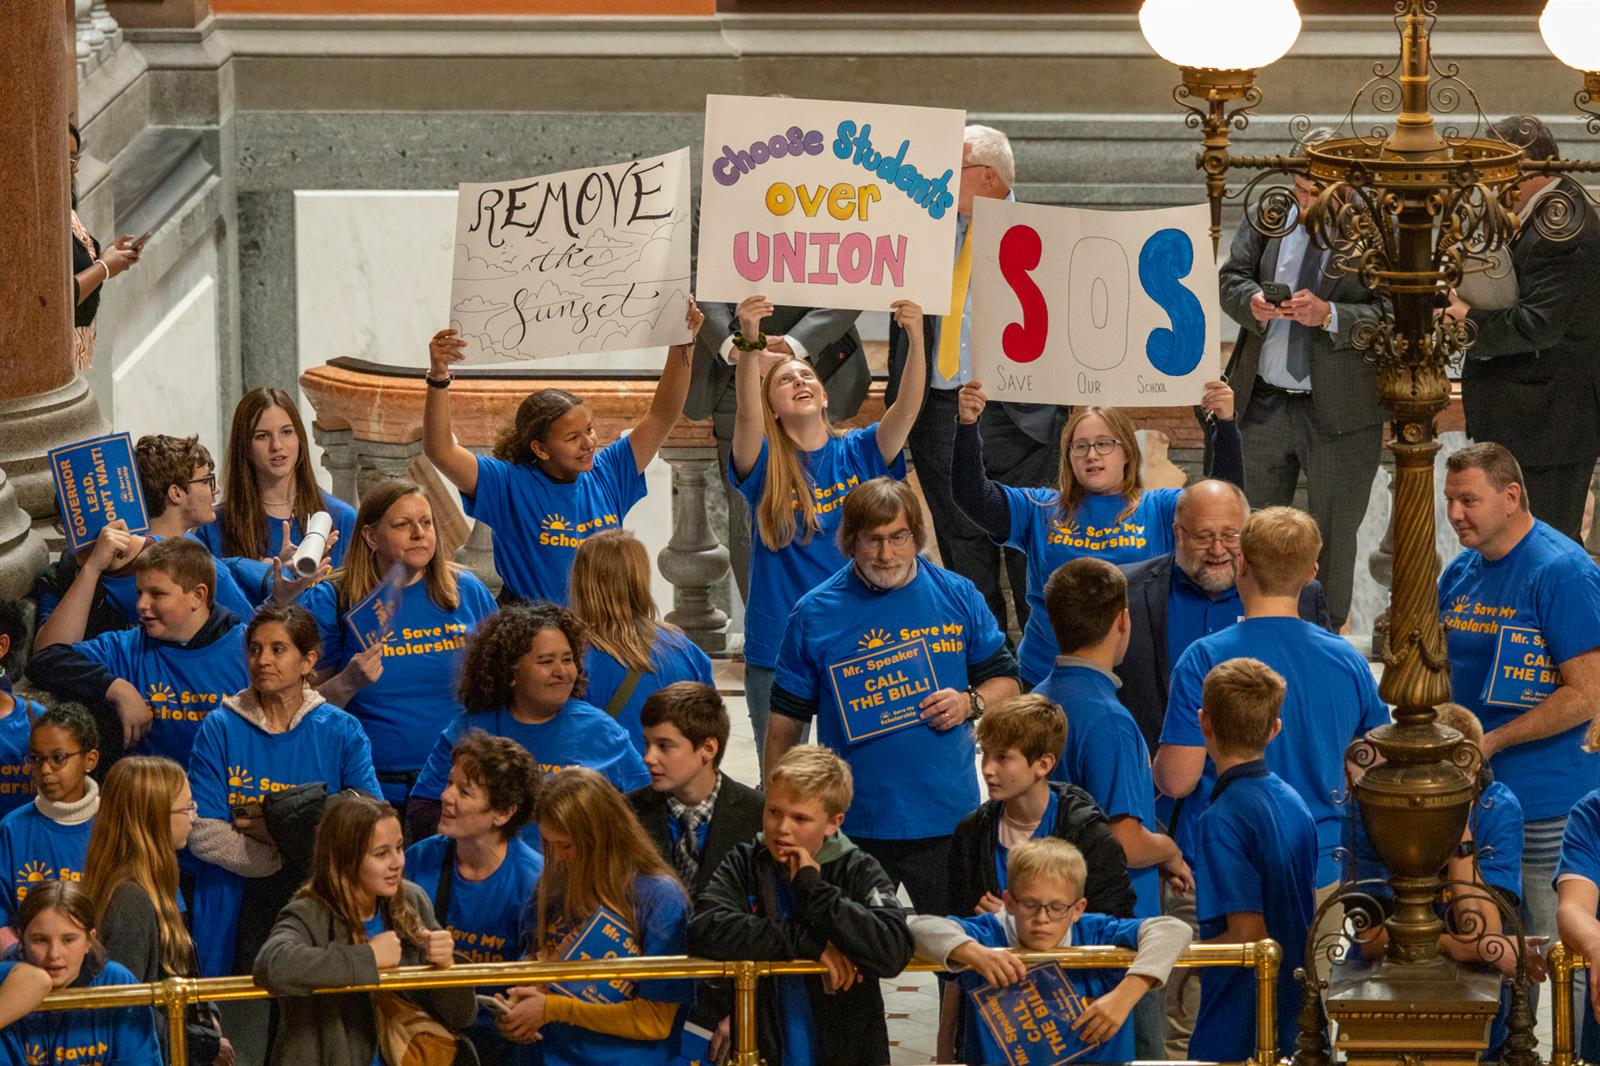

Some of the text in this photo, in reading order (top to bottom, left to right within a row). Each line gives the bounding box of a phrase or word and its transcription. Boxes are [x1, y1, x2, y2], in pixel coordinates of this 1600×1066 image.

[712, 119, 955, 220] Choose Students
[468, 160, 674, 248] REMOVE
[765, 181, 882, 222] over
[530, 242, 595, 272] the
[733, 231, 909, 287] UNION
[502, 283, 659, 350] Sunset
[60, 459, 87, 537] GOVERNOR
[83, 471, 100, 513] LEAD,
[91, 447, 117, 523] ON'T WAIT!
[1047, 532, 1148, 551] Scholarship
[1086, 523, 1146, 538] Save My
[1473, 602, 1517, 620] Save My
[402, 627, 442, 640] Save
[900, 623, 964, 641] Save My
[929, 638, 964, 654] ship
[1511, 632, 1529, 644] Mr.
[842, 647, 919, 678] Mr. Speaker
[1503, 665, 1535, 681] THE
[849, 677, 931, 712] THE BILL!
[864, 670, 909, 692] CALL
[181, 690, 218, 704] Save
[480, 932, 506, 951] My
[602, 923, 620, 942] Mr.
[1013, 999, 1042, 1043] CALL
[1041, 1020, 1067, 1056] THE
